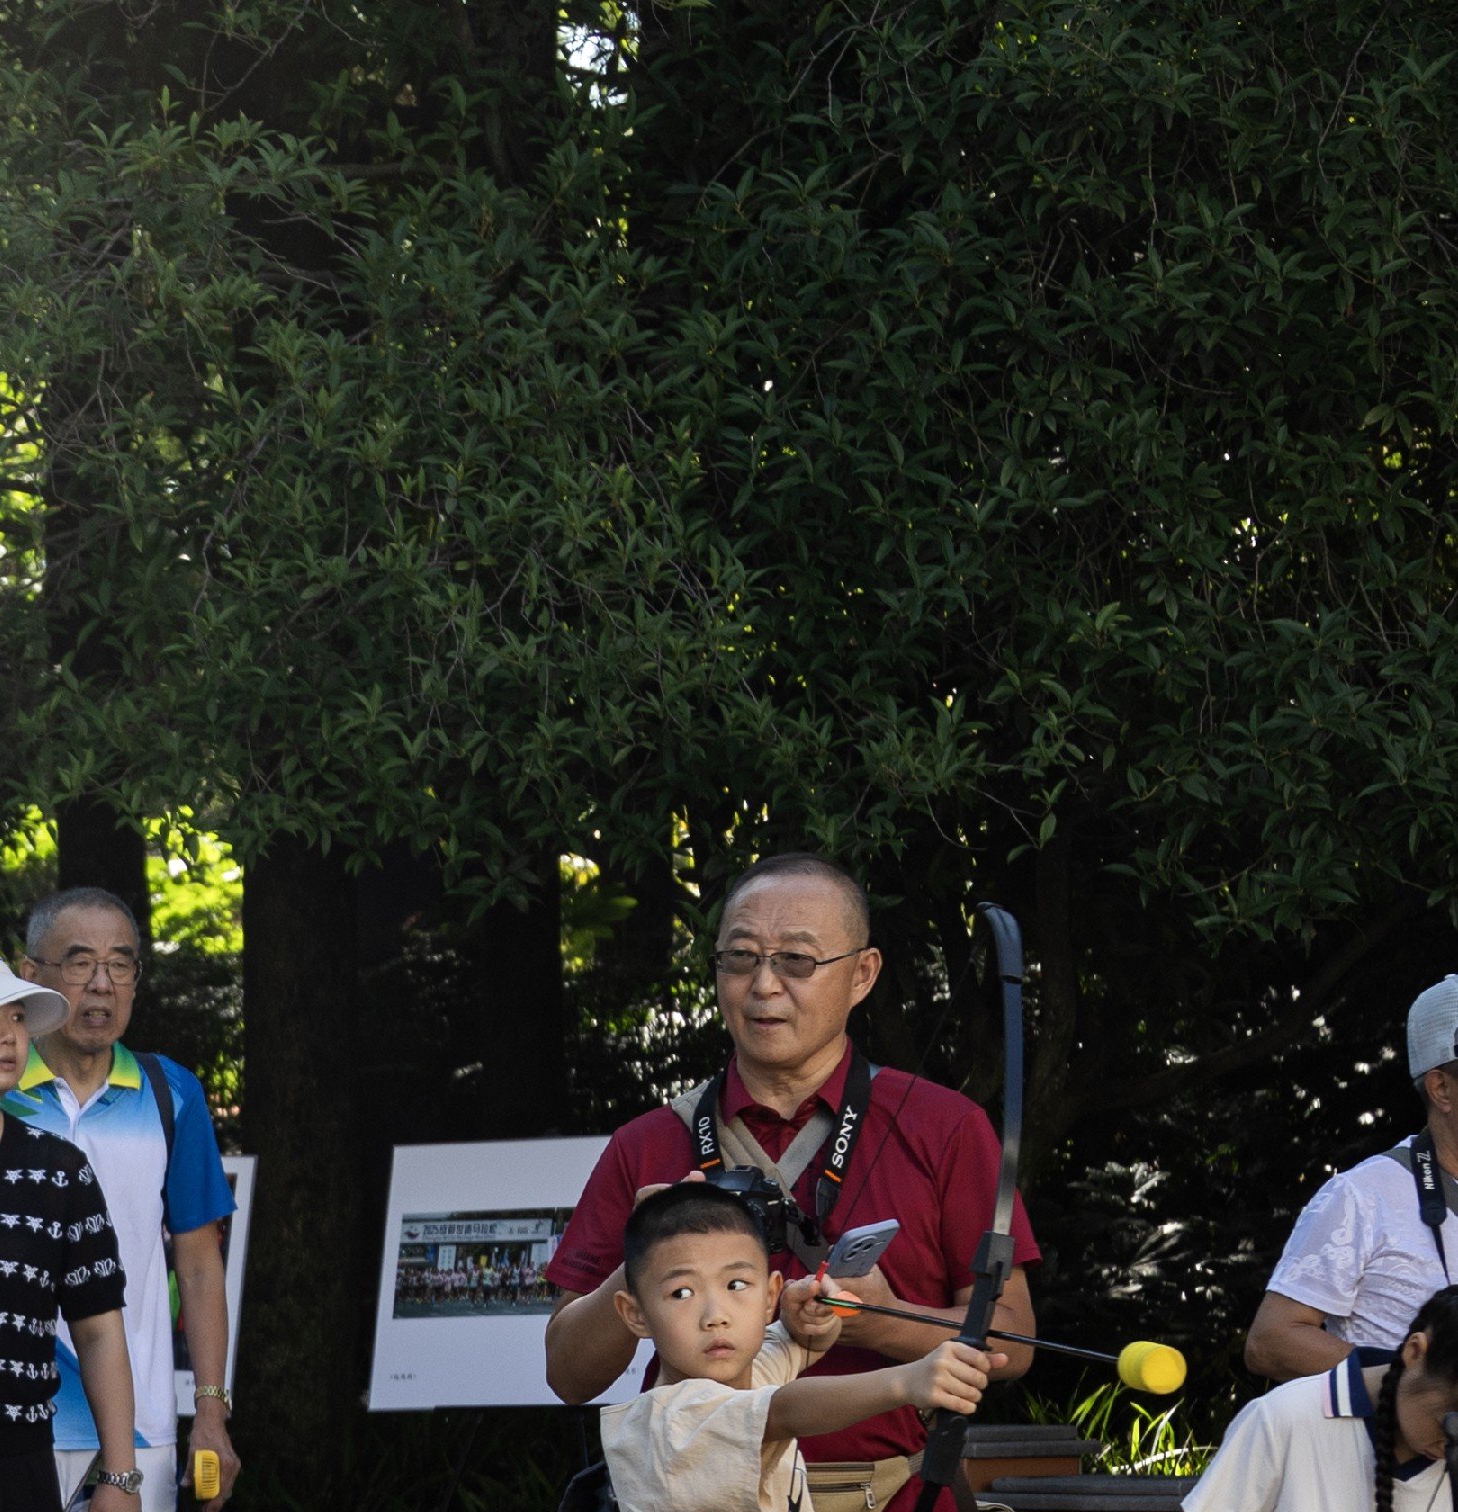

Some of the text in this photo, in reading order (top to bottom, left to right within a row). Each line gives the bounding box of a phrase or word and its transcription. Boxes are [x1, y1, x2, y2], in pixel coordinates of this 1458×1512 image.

[698, 1116, 715, 1155] RX10
[831, 1105, 858, 1169] SONY
[1422, 1163, 1435, 1190] Nikon
